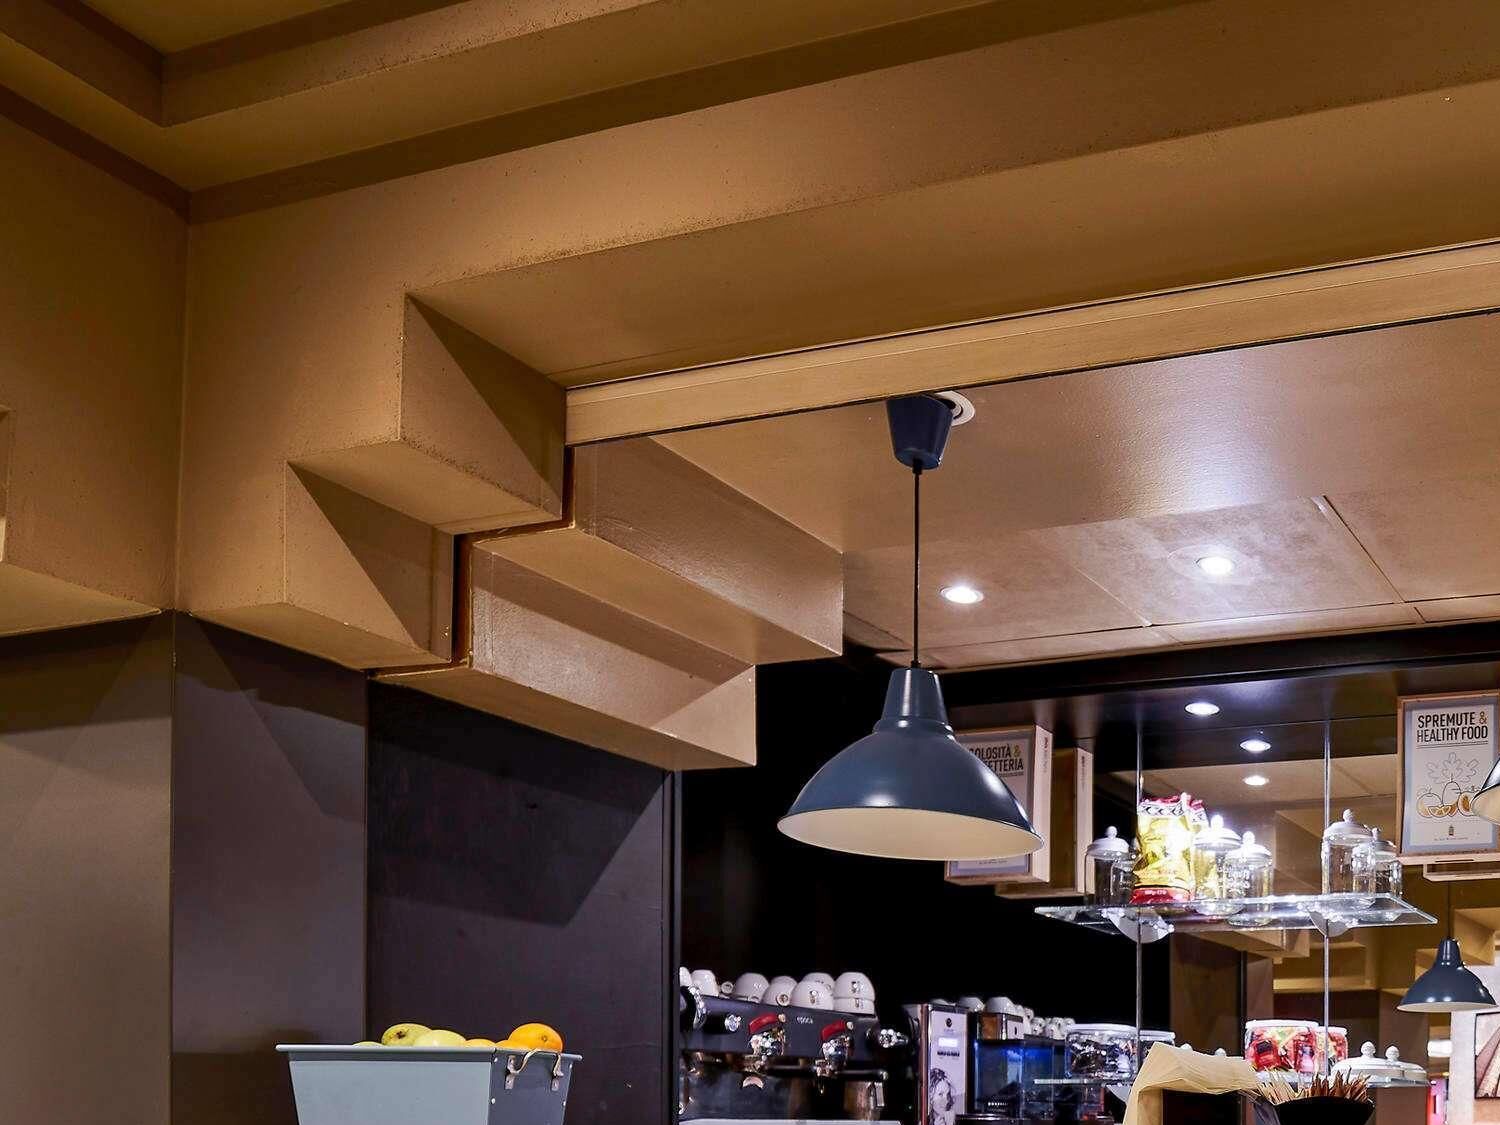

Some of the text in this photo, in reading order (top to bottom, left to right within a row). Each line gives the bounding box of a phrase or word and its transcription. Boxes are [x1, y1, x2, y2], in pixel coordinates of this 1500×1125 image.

[1418, 711, 1488, 728] SPREMUTE &
[1417, 725, 1488, 742] HEALTHY FOOD
